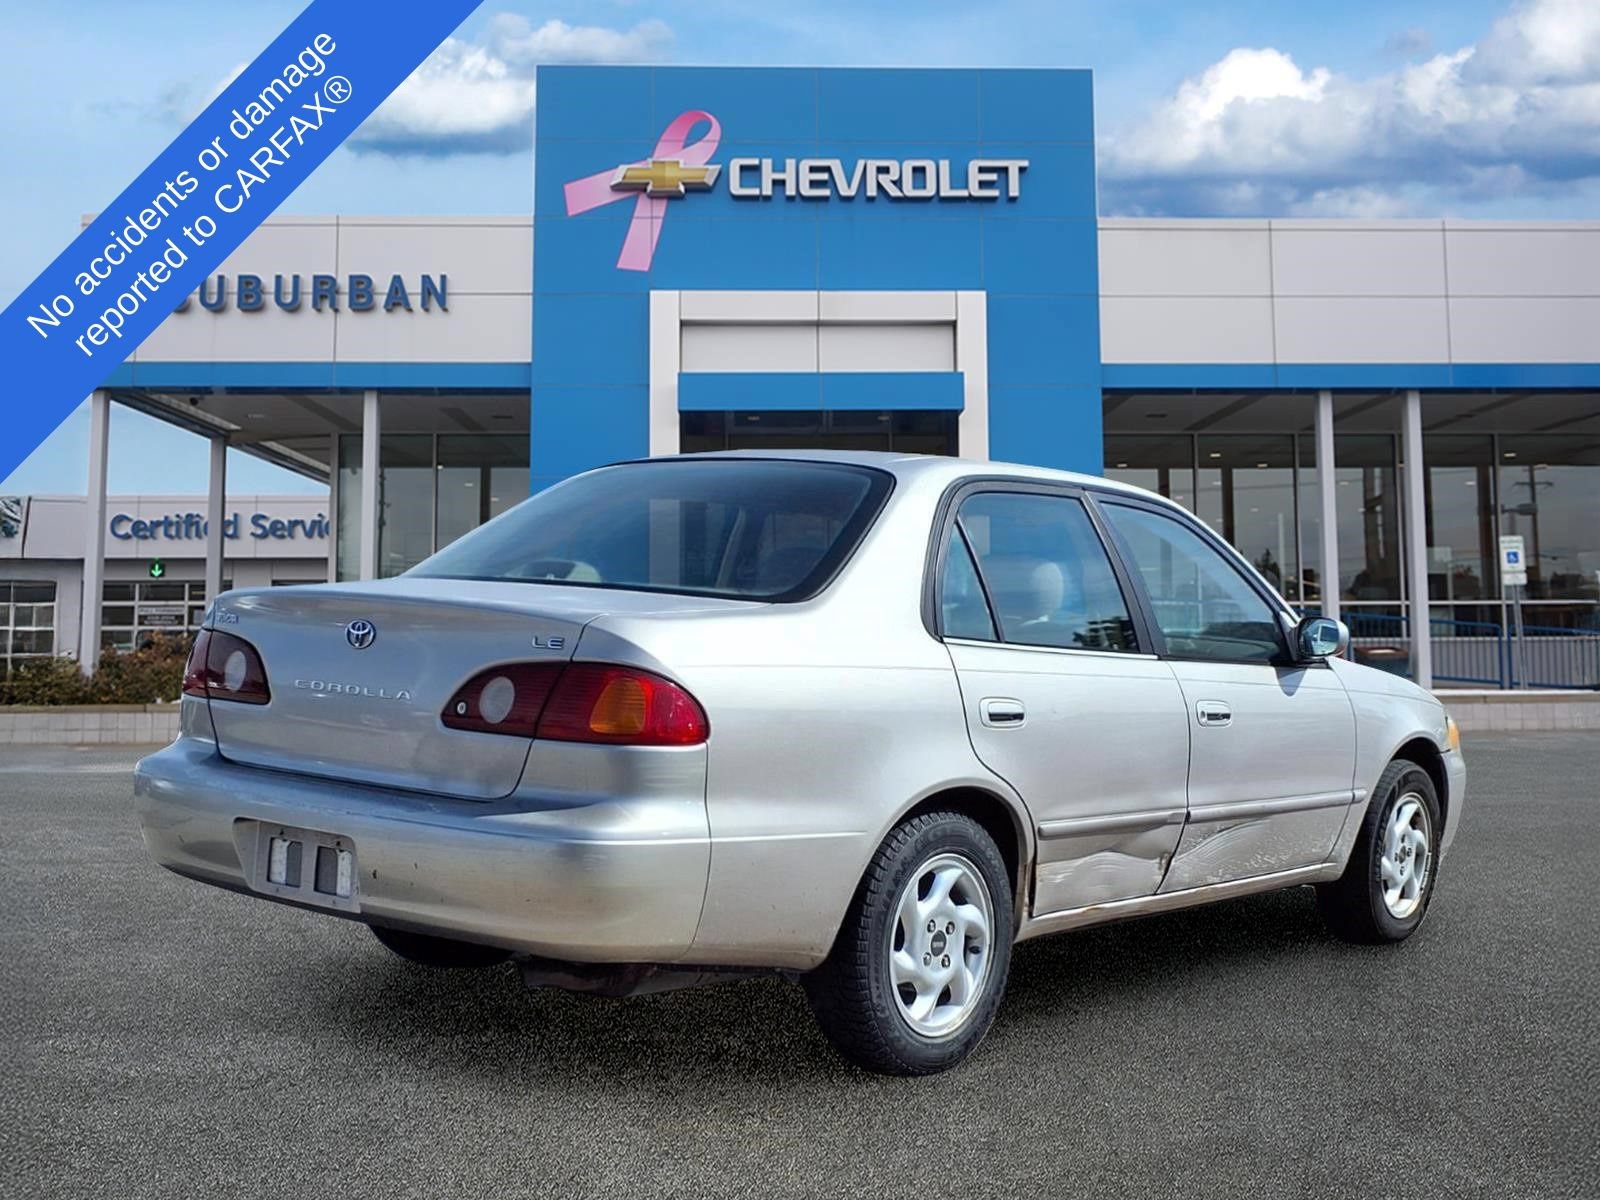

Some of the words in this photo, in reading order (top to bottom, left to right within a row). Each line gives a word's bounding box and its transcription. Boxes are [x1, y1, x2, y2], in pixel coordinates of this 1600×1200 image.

[728, 157, 1030, 200] CHEVROLET
[110, 513, 240, 541] Certifid
[532, 636, 565, 650] LE
[295, 679, 412, 701] COROLLA
